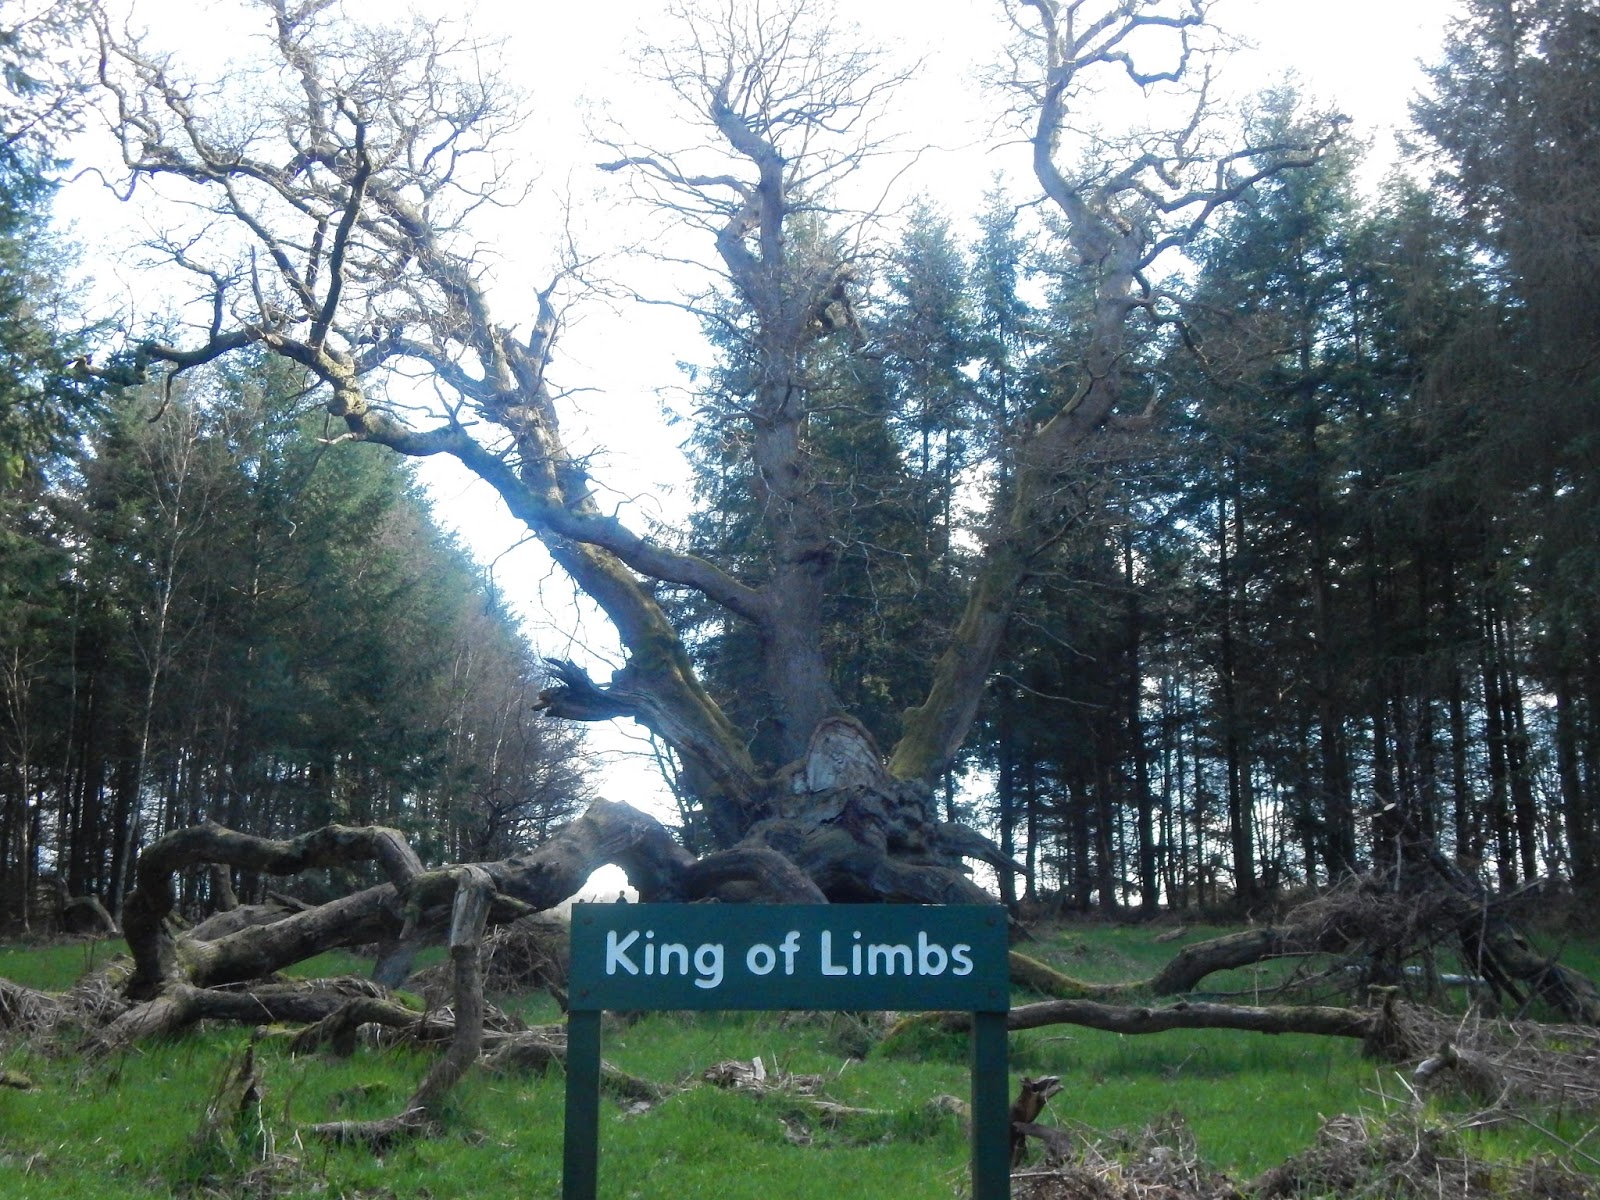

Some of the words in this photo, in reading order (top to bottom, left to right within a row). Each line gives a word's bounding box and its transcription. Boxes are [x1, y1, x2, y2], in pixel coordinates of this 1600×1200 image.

[605, 930, 724, 989] King
[746, 930, 801, 975] of
[821, 930, 974, 976] Limbs
